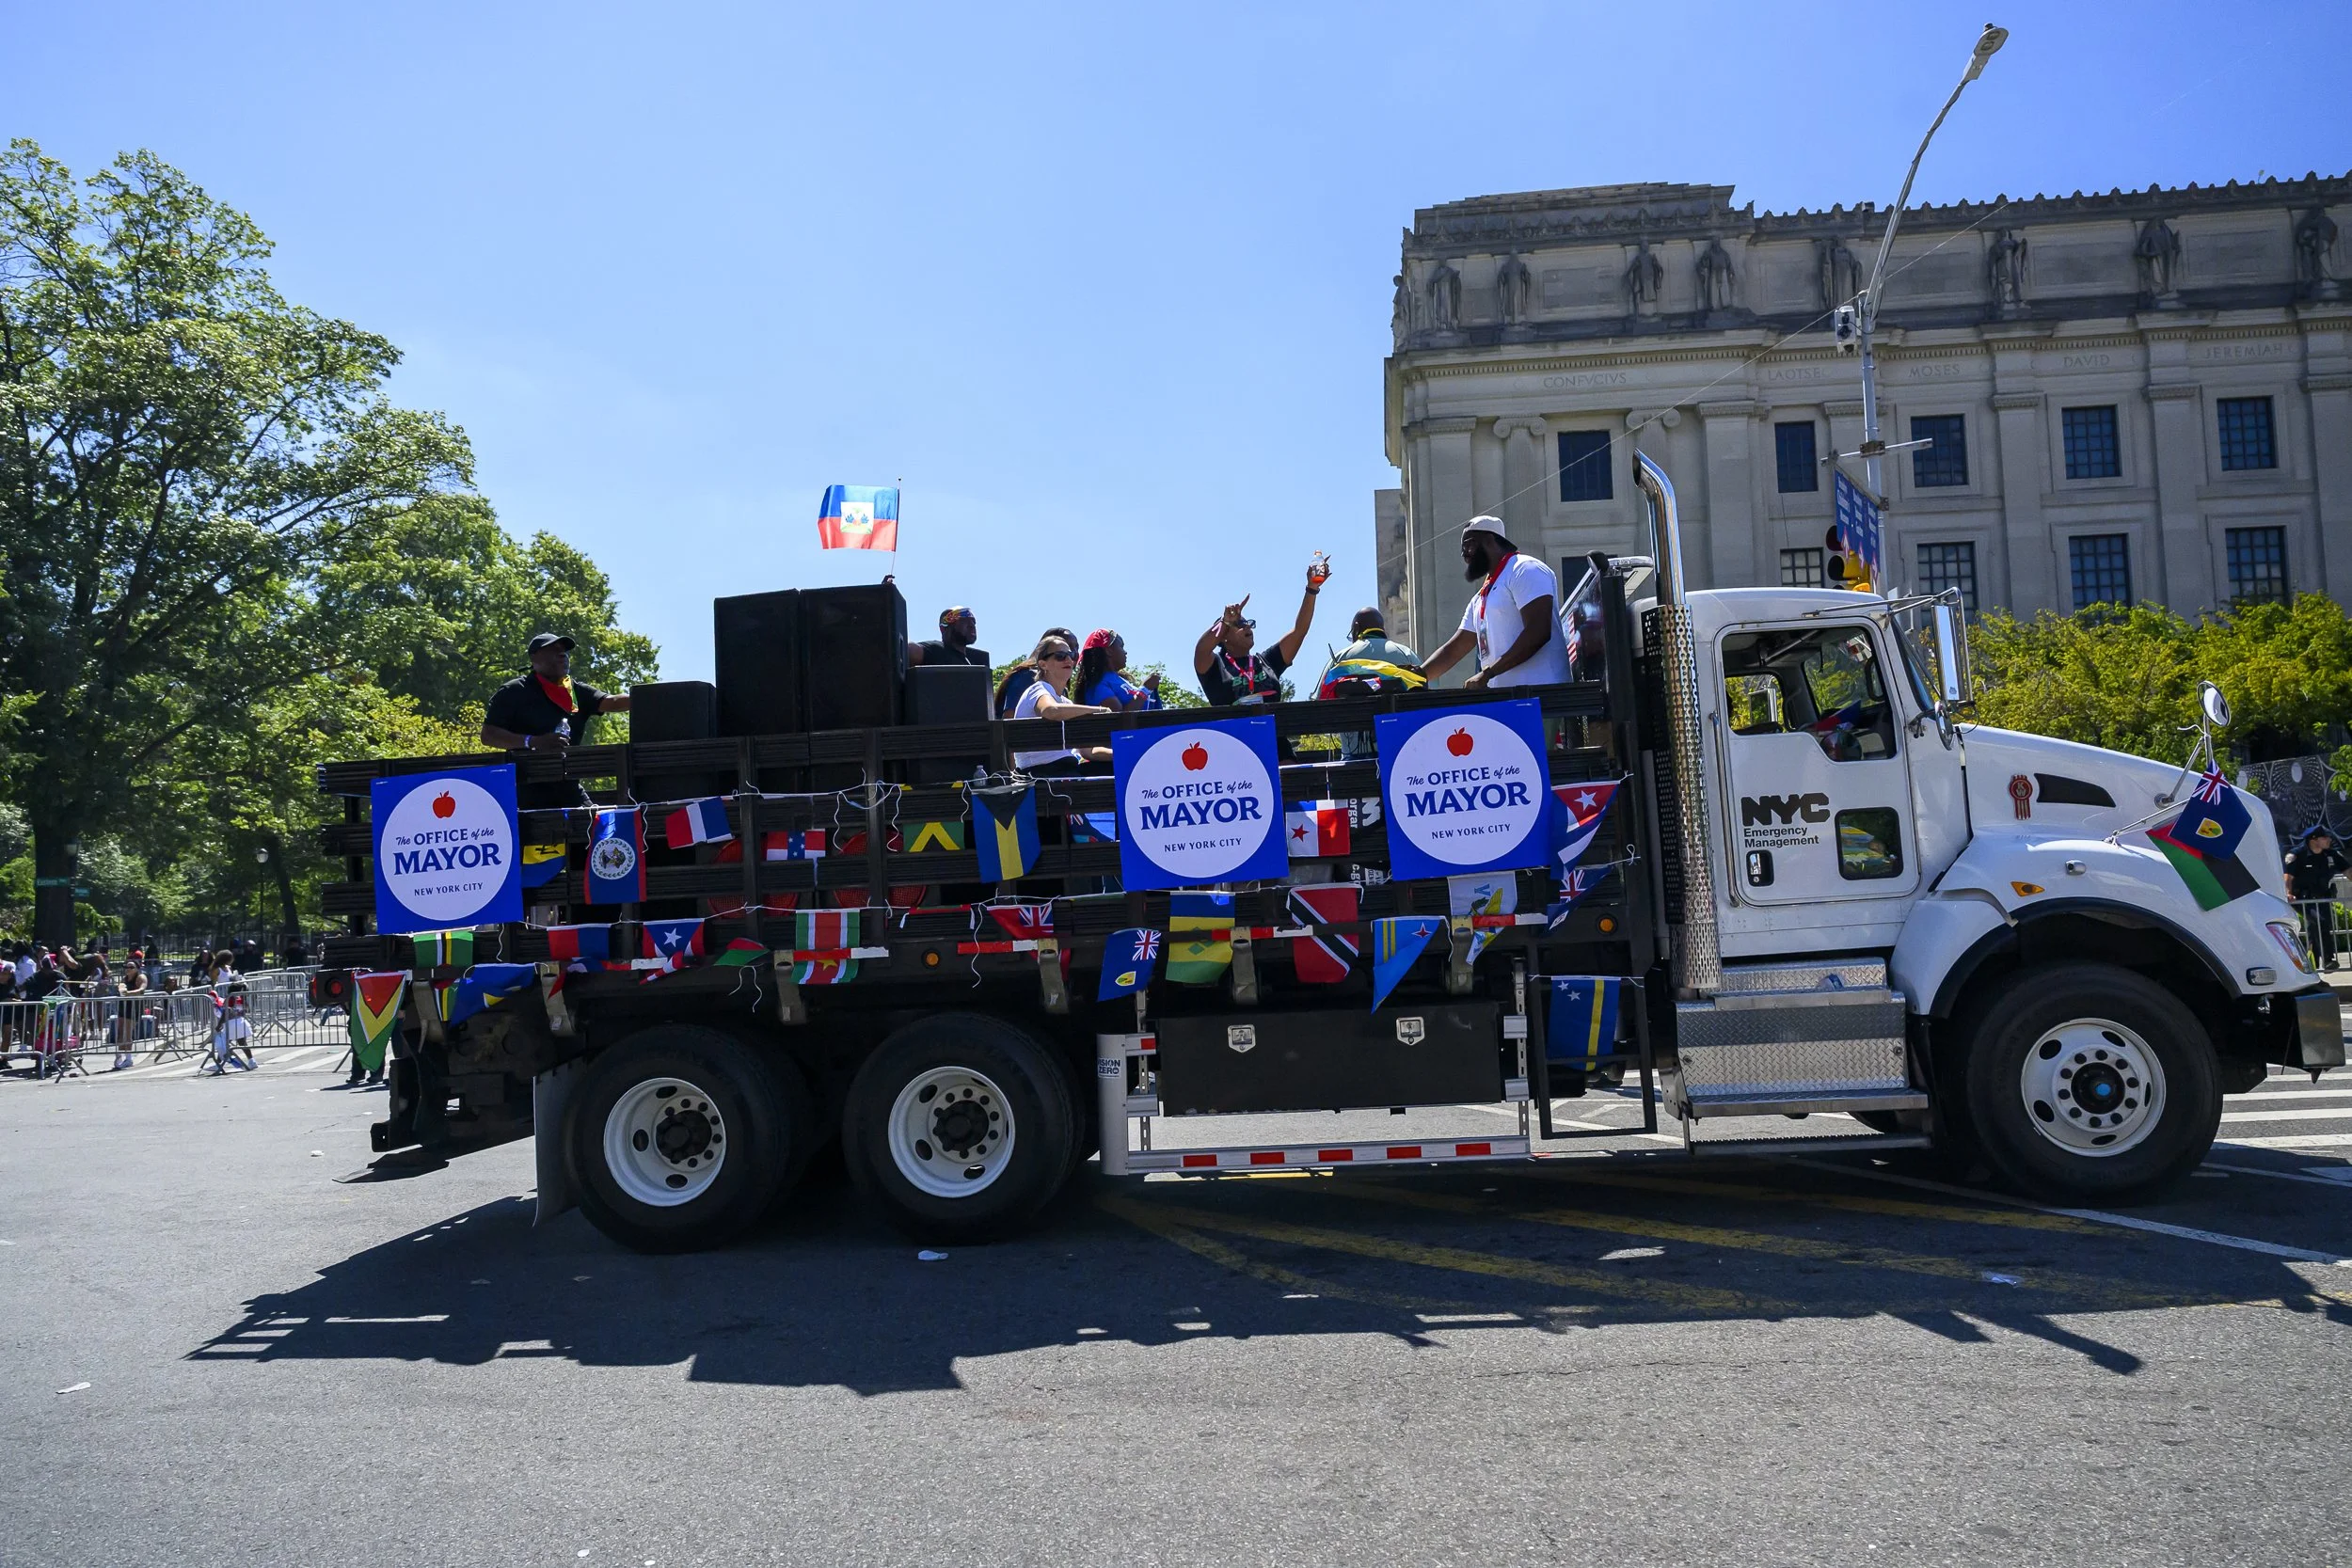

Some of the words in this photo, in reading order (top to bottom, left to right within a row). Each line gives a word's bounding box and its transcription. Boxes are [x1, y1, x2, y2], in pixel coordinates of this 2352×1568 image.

[2204, 342, 2283, 359] JEREMIAH
[1908, 363, 1961, 377] MOSES
[2063, 354, 2110, 370] DAVID
[1768, 367, 1821, 382] LAOTSE
[1406, 776, 1424, 786] The
[1427, 767, 1490, 785] OFFICE
[1493, 766, 1504, 780] of
[1504, 765, 1520, 776] the
[1141, 789, 1159, 800] The
[1162, 782, 1223, 799] OFFICE
[1226, 781, 1237, 792] of
[1237, 780, 1253, 790] the
[1405, 781, 1532, 817] MAYOR
[1138, 796, 1263, 831] MAYOR
[1740, 792, 1831, 827] NYC
[395, 836, 411, 846] The
[414, 829, 469, 845] OFFICE
[470, 828, 481, 839] of
[481, 828, 495, 837] the
[1431, 829, 1454, 840] NEW
[1457, 826, 1485, 837] YORK
[1488, 823, 1511, 833] CITY
[1743, 826, 1808, 838] Emergency
[1164, 842, 1186, 852] NEW
[1189, 840, 1216, 850] YORK
[1219, 837, 1242, 847] CITY
[1744, 835, 1820, 848] Management
[393, 843, 501, 875] MAYOR
[414, 887, 434, 896] NEW
[437, 884, 460, 895] YORK
[463, 882, 484, 892] CITY
[1098, 1067, 1120, 1075] ZERO
